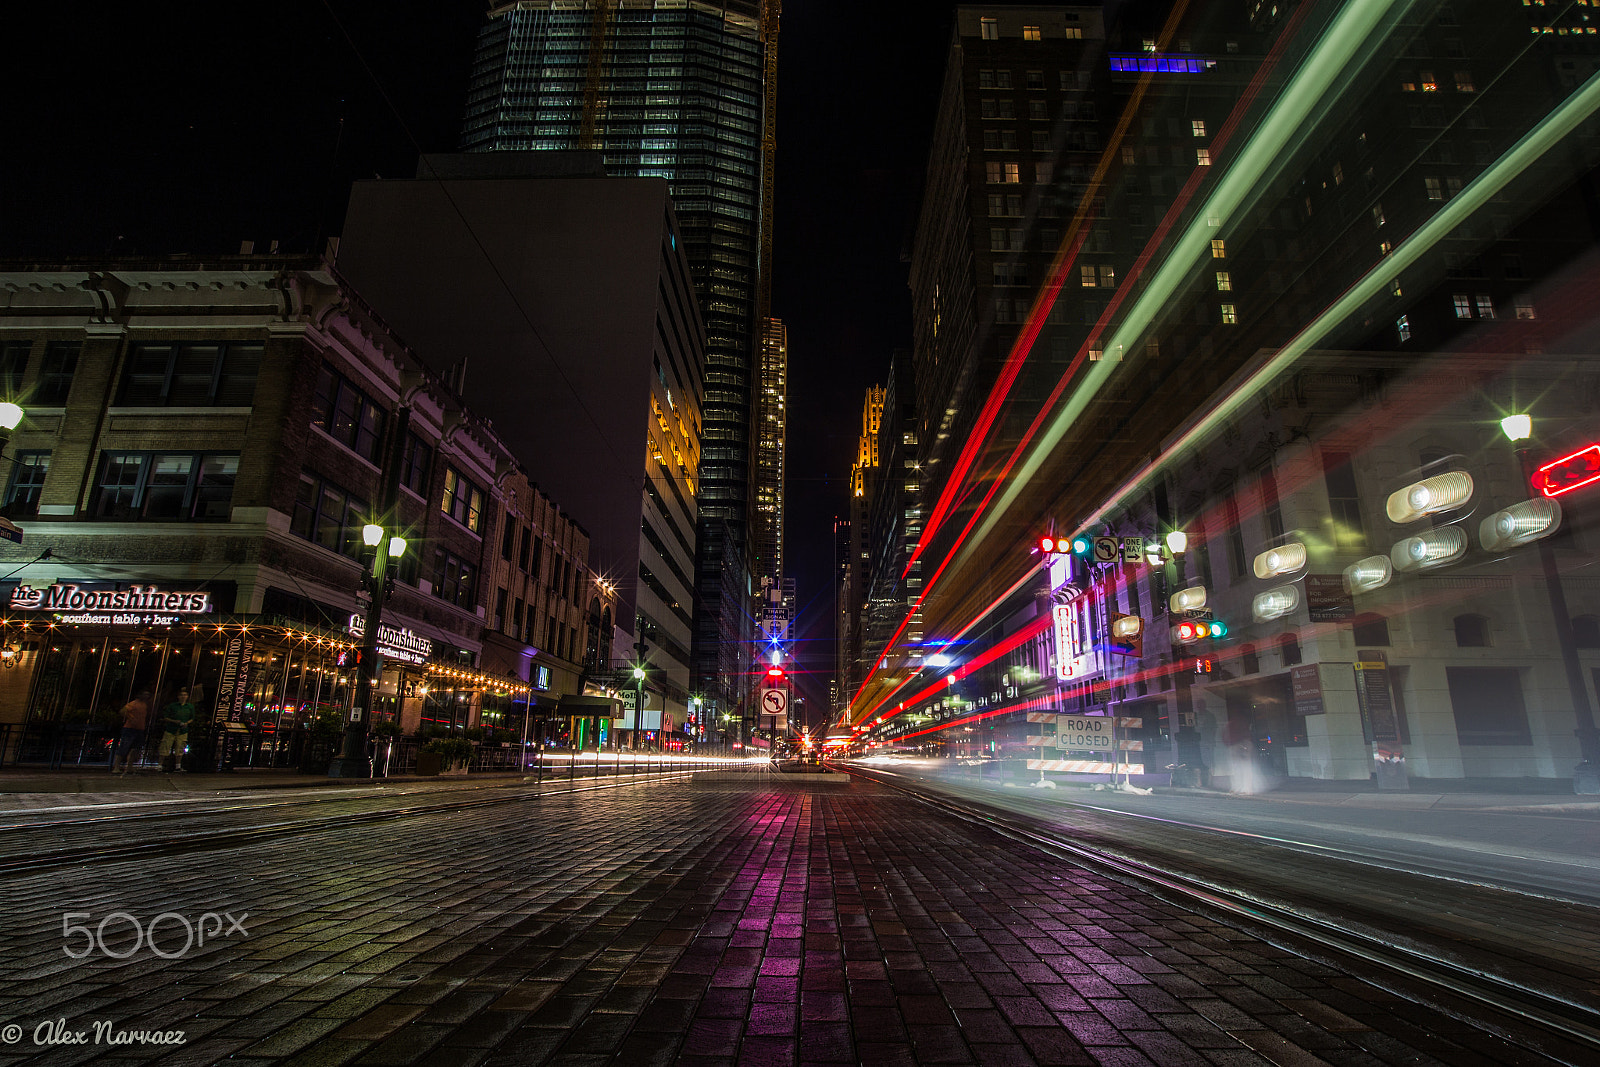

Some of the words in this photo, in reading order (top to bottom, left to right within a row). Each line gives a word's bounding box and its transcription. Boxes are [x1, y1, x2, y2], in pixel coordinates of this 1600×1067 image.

[0, 529, 11, 539] ain
[10, 586, 40, 600] the
[44, 585, 207, 610] Moonshiners
[62, 613, 111, 624] southern
[112, 614, 140, 624] table
[153, 614, 174, 625] bar
[228, 638, 242, 655] FOOD
[241, 639, 254, 664] WINE
[221, 657, 239, 695] SOUTHERN
[1068, 720, 1102, 731] ROAD
[1061, 734, 1109, 746] CLOSED
